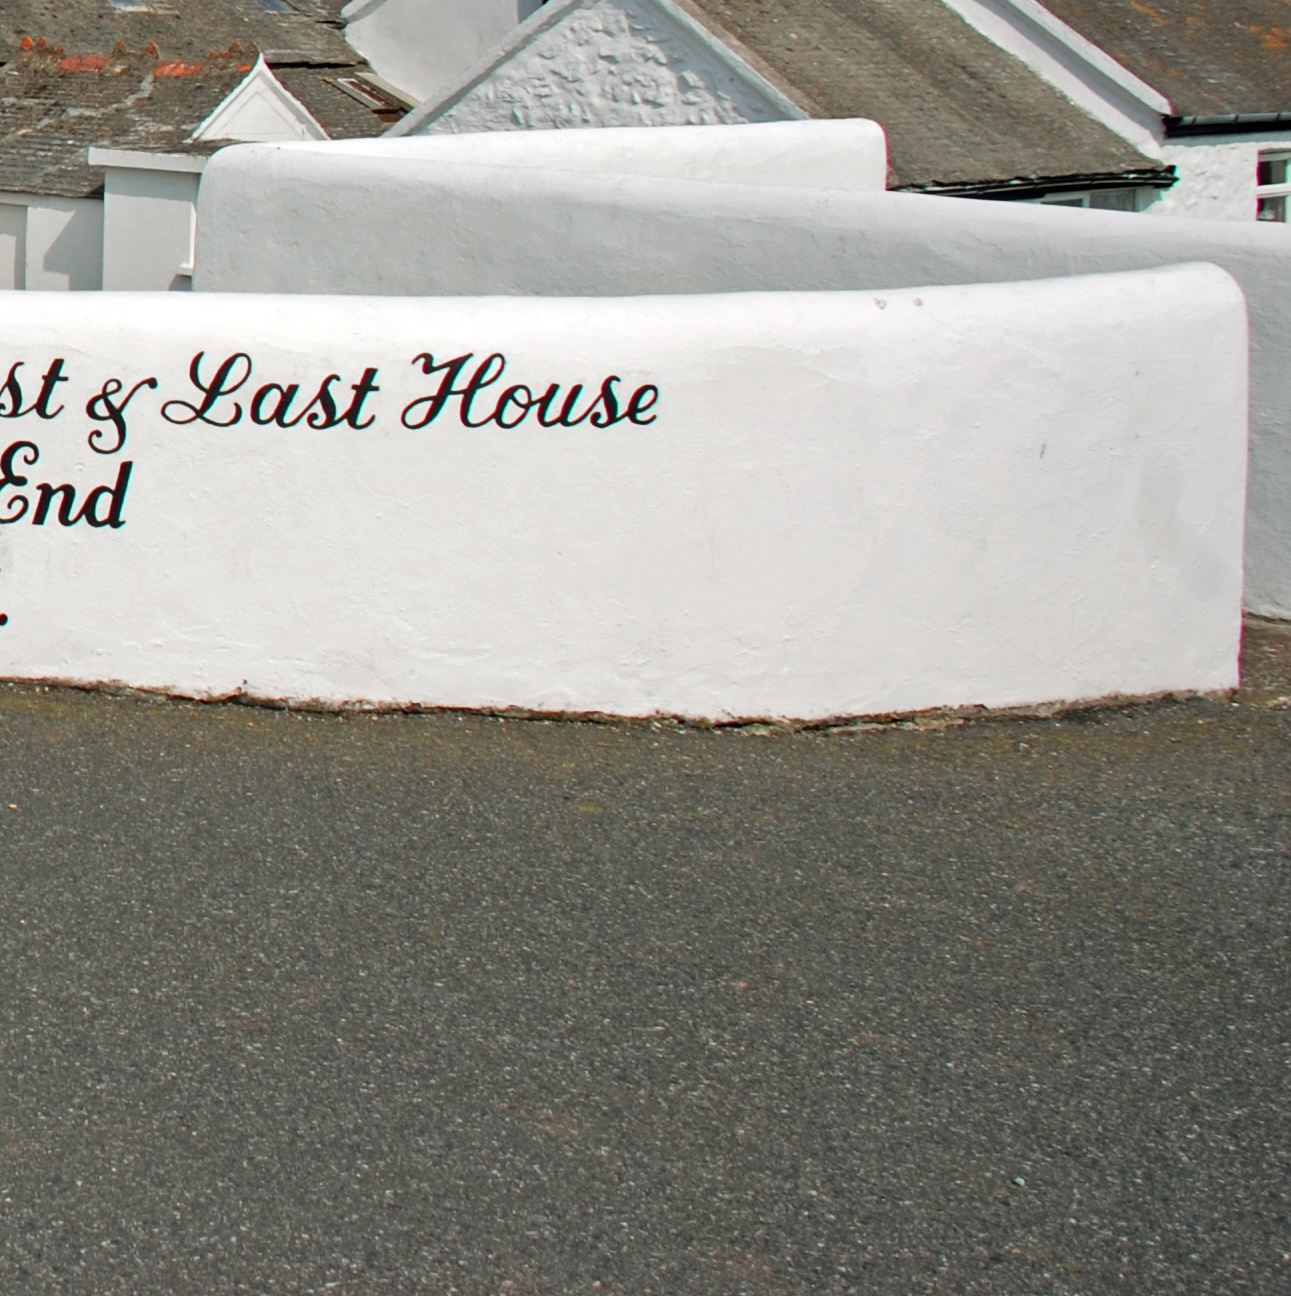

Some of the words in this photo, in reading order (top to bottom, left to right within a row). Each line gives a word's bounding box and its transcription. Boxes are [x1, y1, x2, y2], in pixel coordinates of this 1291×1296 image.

[85, 377, 158, 455] &
[160, 351, 380, 431] Last
[400, 352, 659, 430] House
